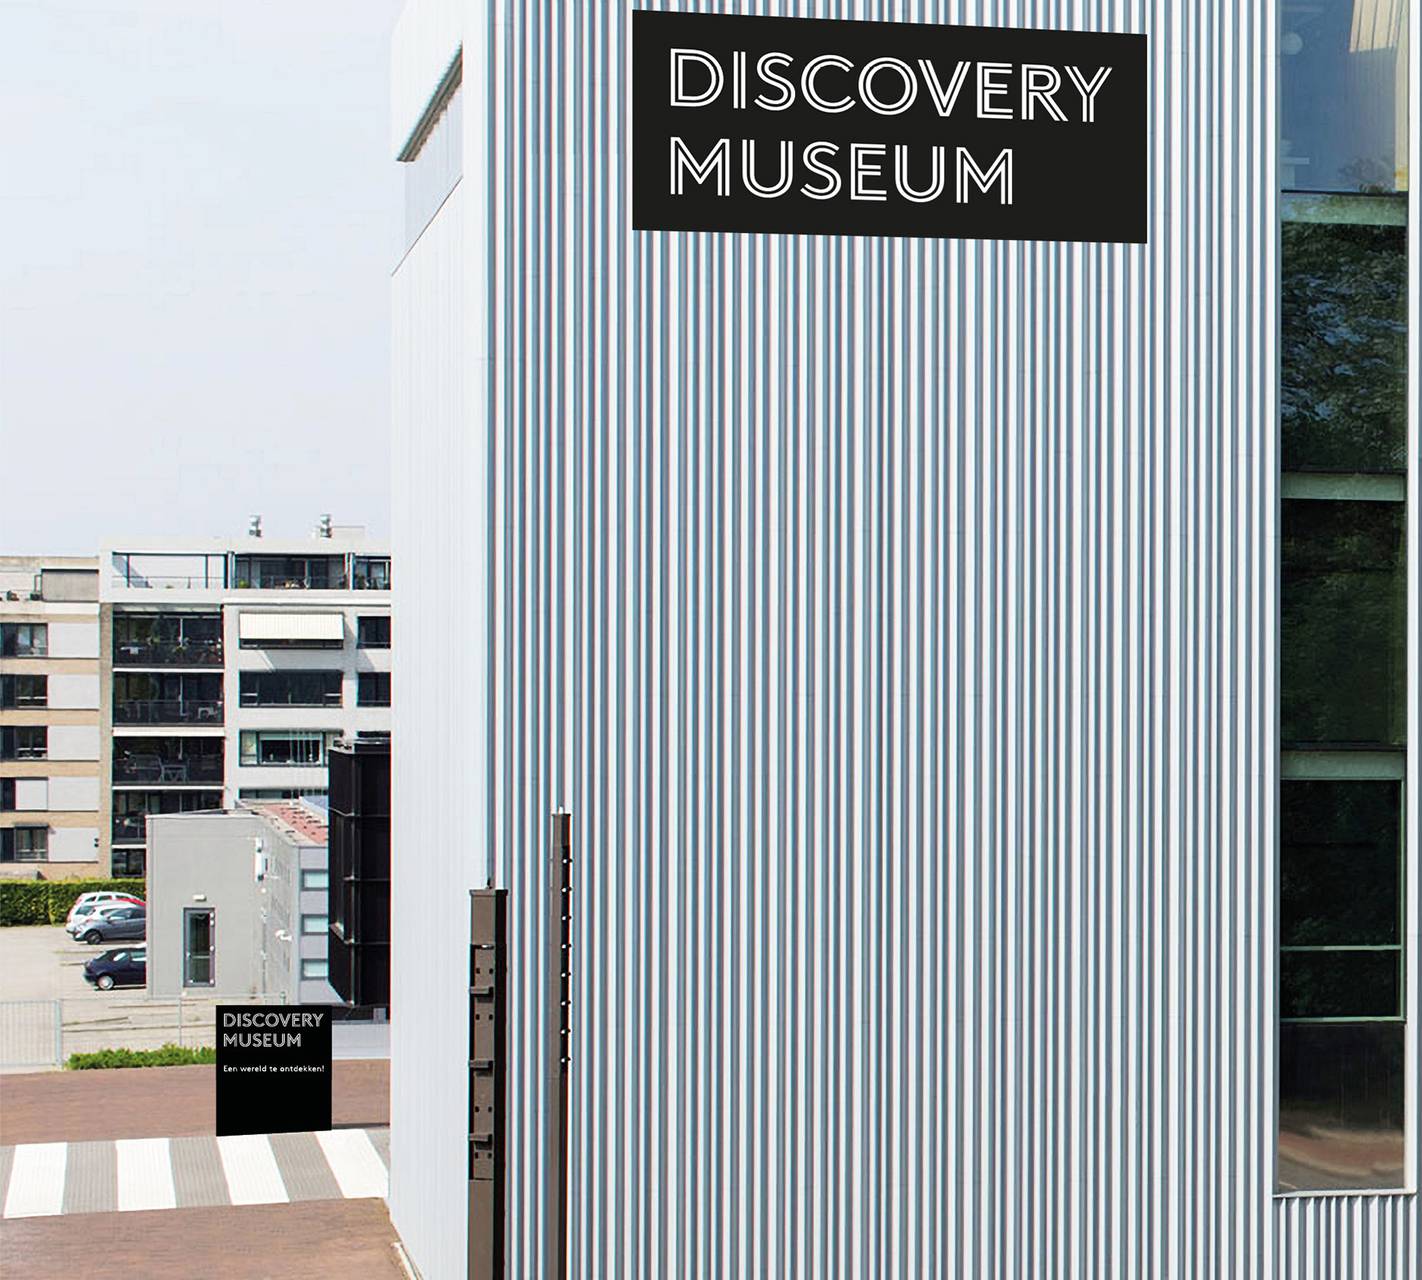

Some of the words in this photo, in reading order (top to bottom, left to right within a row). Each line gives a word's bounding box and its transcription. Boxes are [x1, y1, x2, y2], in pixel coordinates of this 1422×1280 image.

[670, 47, 1113, 123] DISCOVERY
[670, 136, 1013, 205] MUSEUM
[223, 1012, 324, 1028] DISCOVERY
[223, 1032, 302, 1048] MUSEUM
[223, 1064, 238, 1073] Een
[239, 1064, 267, 1073] wereld
[268, 1065, 278, 1073] te
[279, 1064, 325, 1073] ontdekken!
